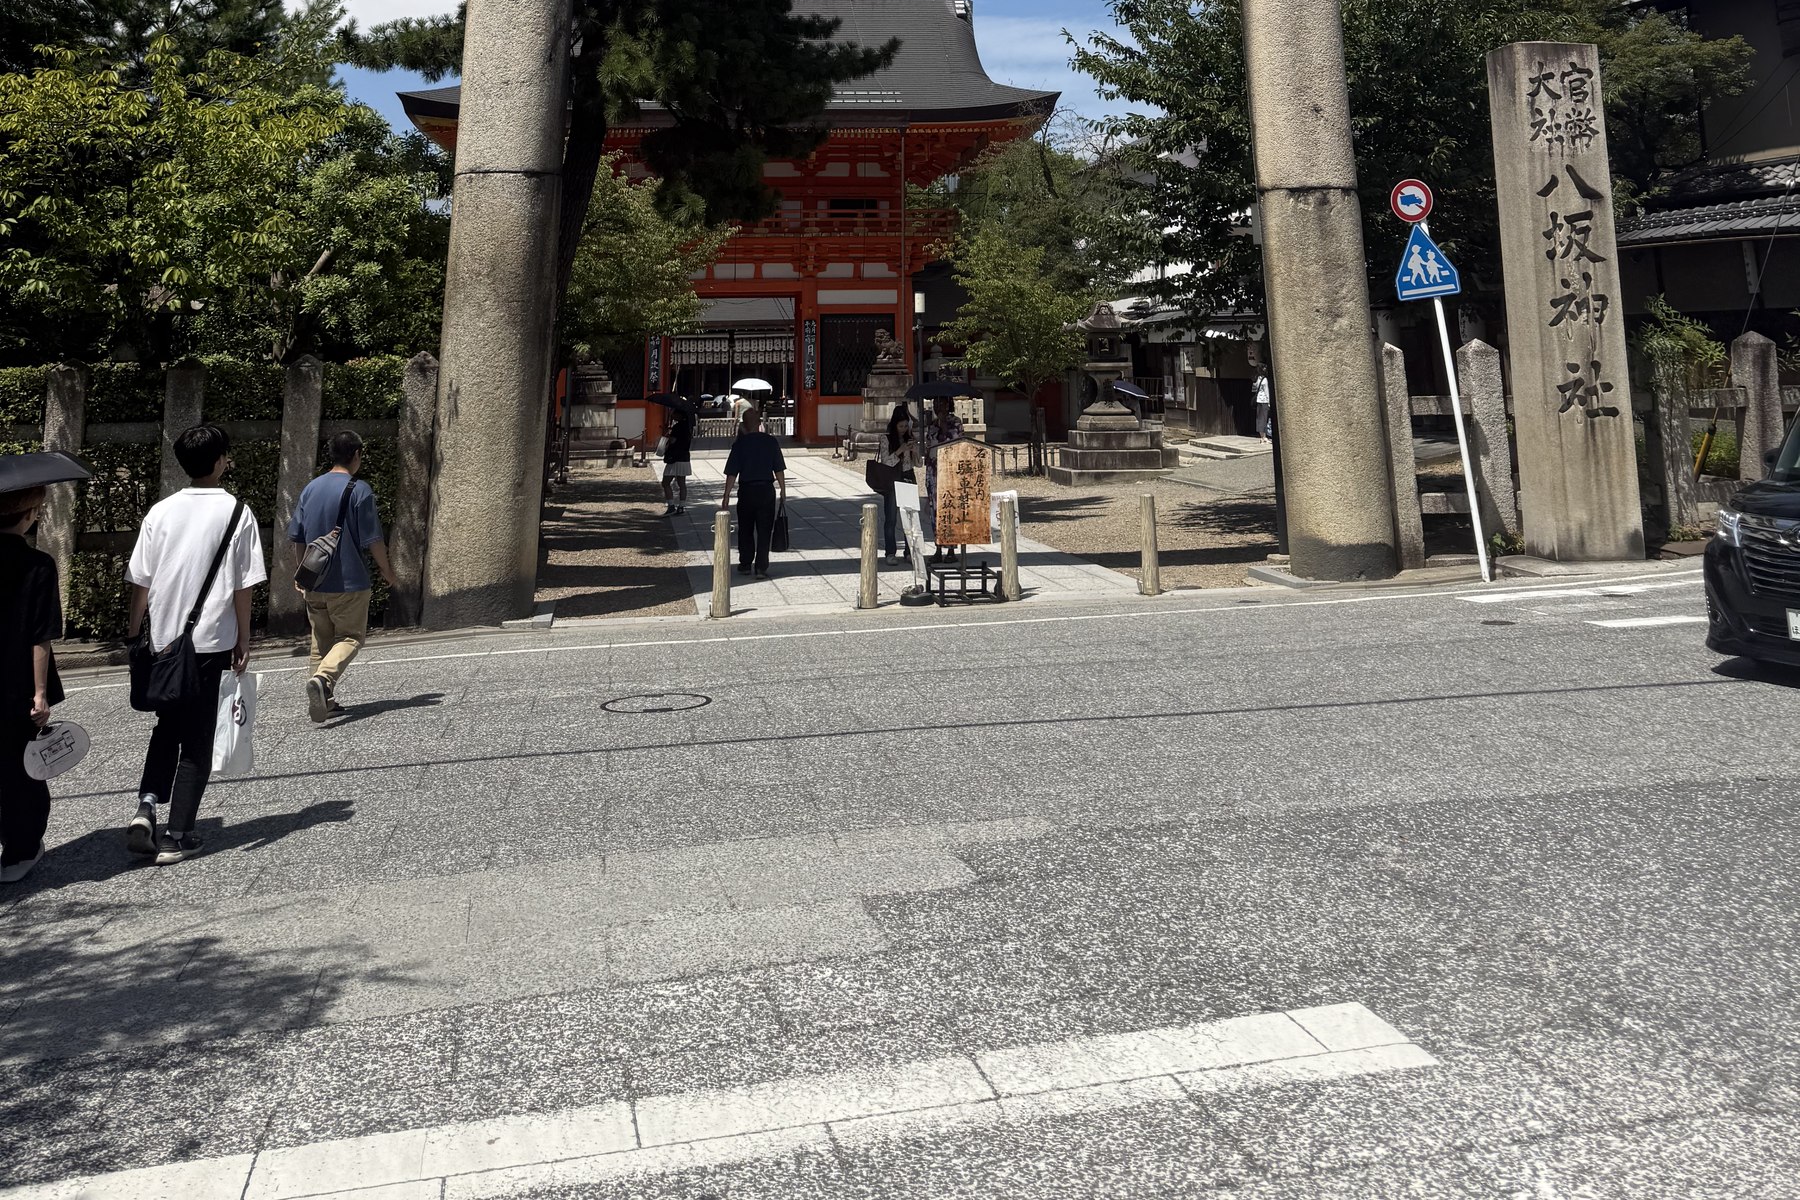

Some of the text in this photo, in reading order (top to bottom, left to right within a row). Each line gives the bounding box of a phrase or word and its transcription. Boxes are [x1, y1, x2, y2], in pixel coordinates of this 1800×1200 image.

[1526, 61, 1564, 150] 大社
[1560, 62, 1600, 148] 官幣
[1536, 164, 1620, 418] 八坂神社
[942, 490, 956, 540] 八坂神社
[954, 460, 974, 525] 駐車禁止
